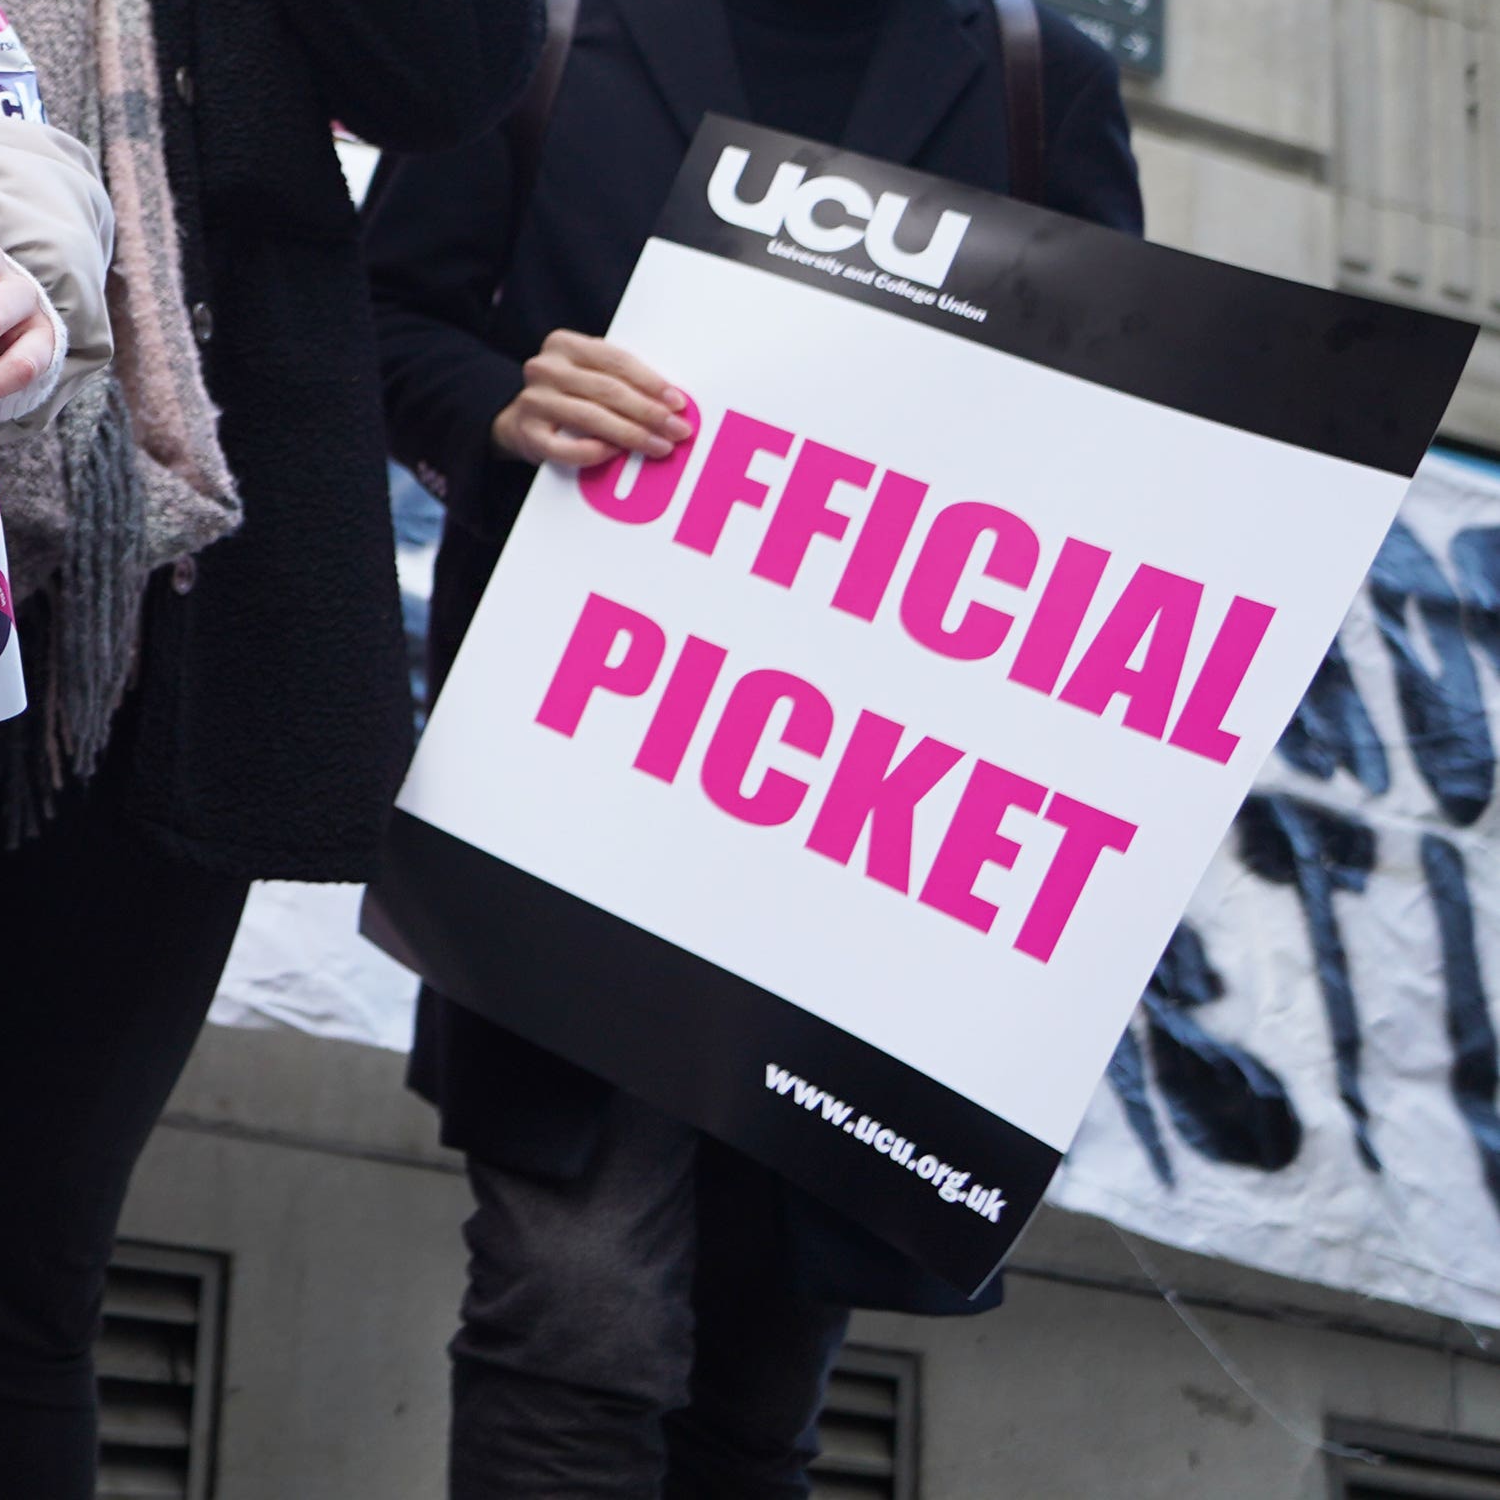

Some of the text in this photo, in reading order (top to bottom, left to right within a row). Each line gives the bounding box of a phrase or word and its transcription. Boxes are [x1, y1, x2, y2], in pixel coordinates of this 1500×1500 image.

[766, 238, 988, 324] University and College Union
[575, 386, 1278, 766] OFFICIAL
[533, 591, 1139, 965] PICKET
[764, 1061, 1008, 1225] www.ucu.org.uk
